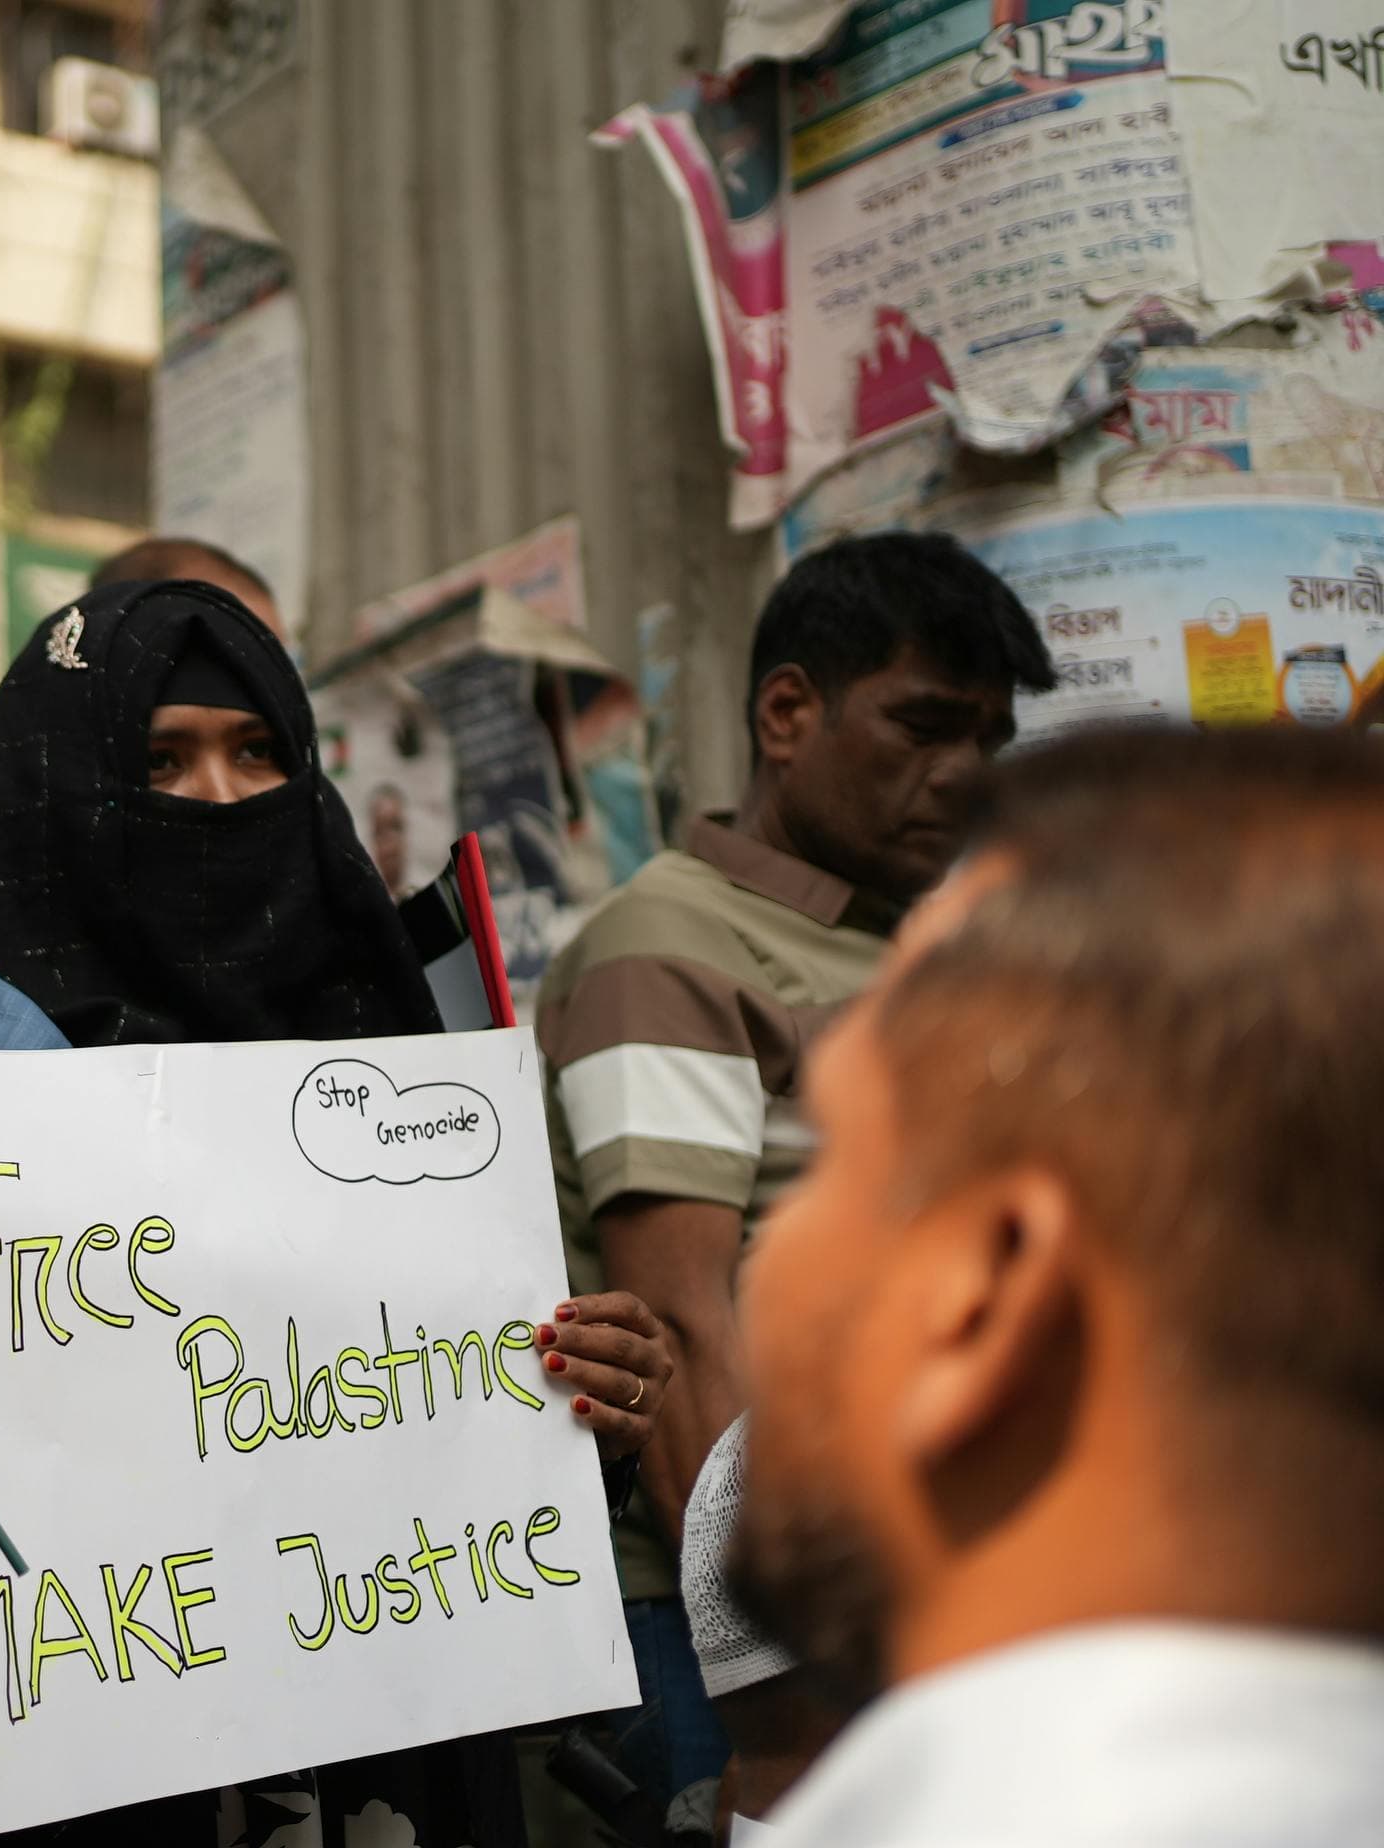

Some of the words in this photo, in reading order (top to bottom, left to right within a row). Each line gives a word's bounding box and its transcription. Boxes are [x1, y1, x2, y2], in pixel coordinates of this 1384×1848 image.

[316, 1076, 370, 1117] Stop
[376, 1105, 480, 1145] Genocide
[176, 1301, 546, 1463] Palastine
[275, 1505, 582, 1653] Justice
